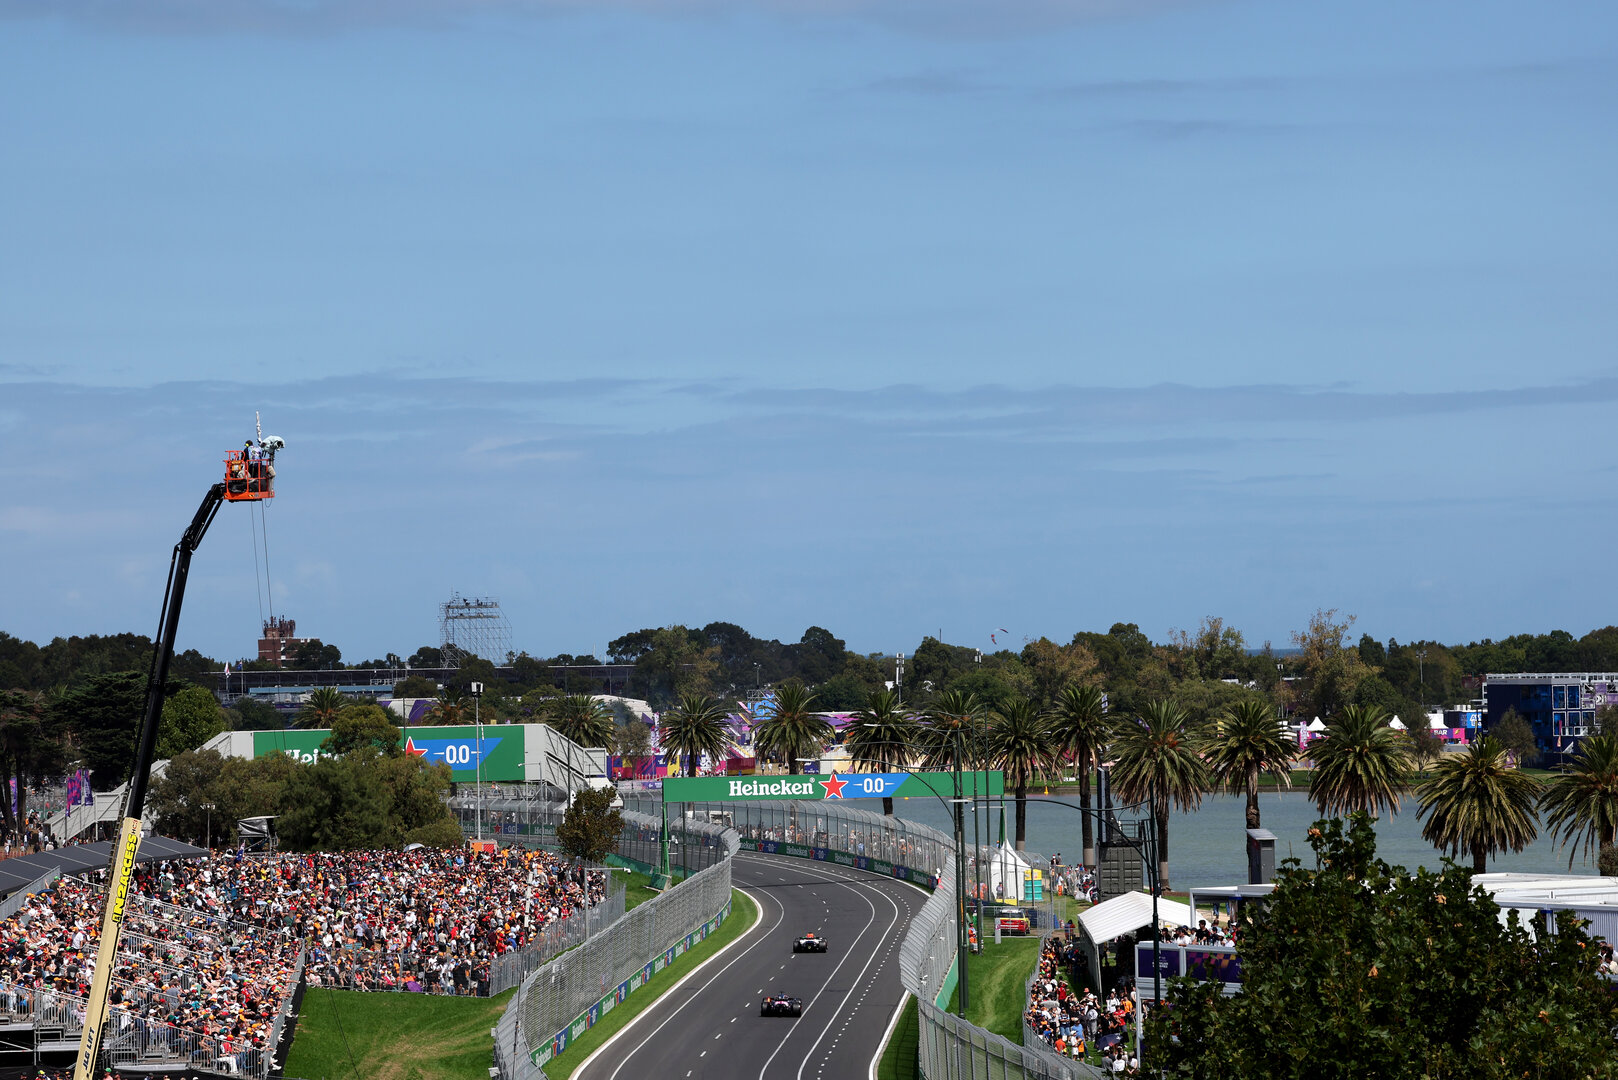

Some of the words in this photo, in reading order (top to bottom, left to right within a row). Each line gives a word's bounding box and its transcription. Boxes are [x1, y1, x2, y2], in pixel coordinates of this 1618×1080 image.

[728, 780, 814, 796] Heineken
[863, 778, 884, 794] 0.0
[87, 1026, 95, 1049] LIFT
